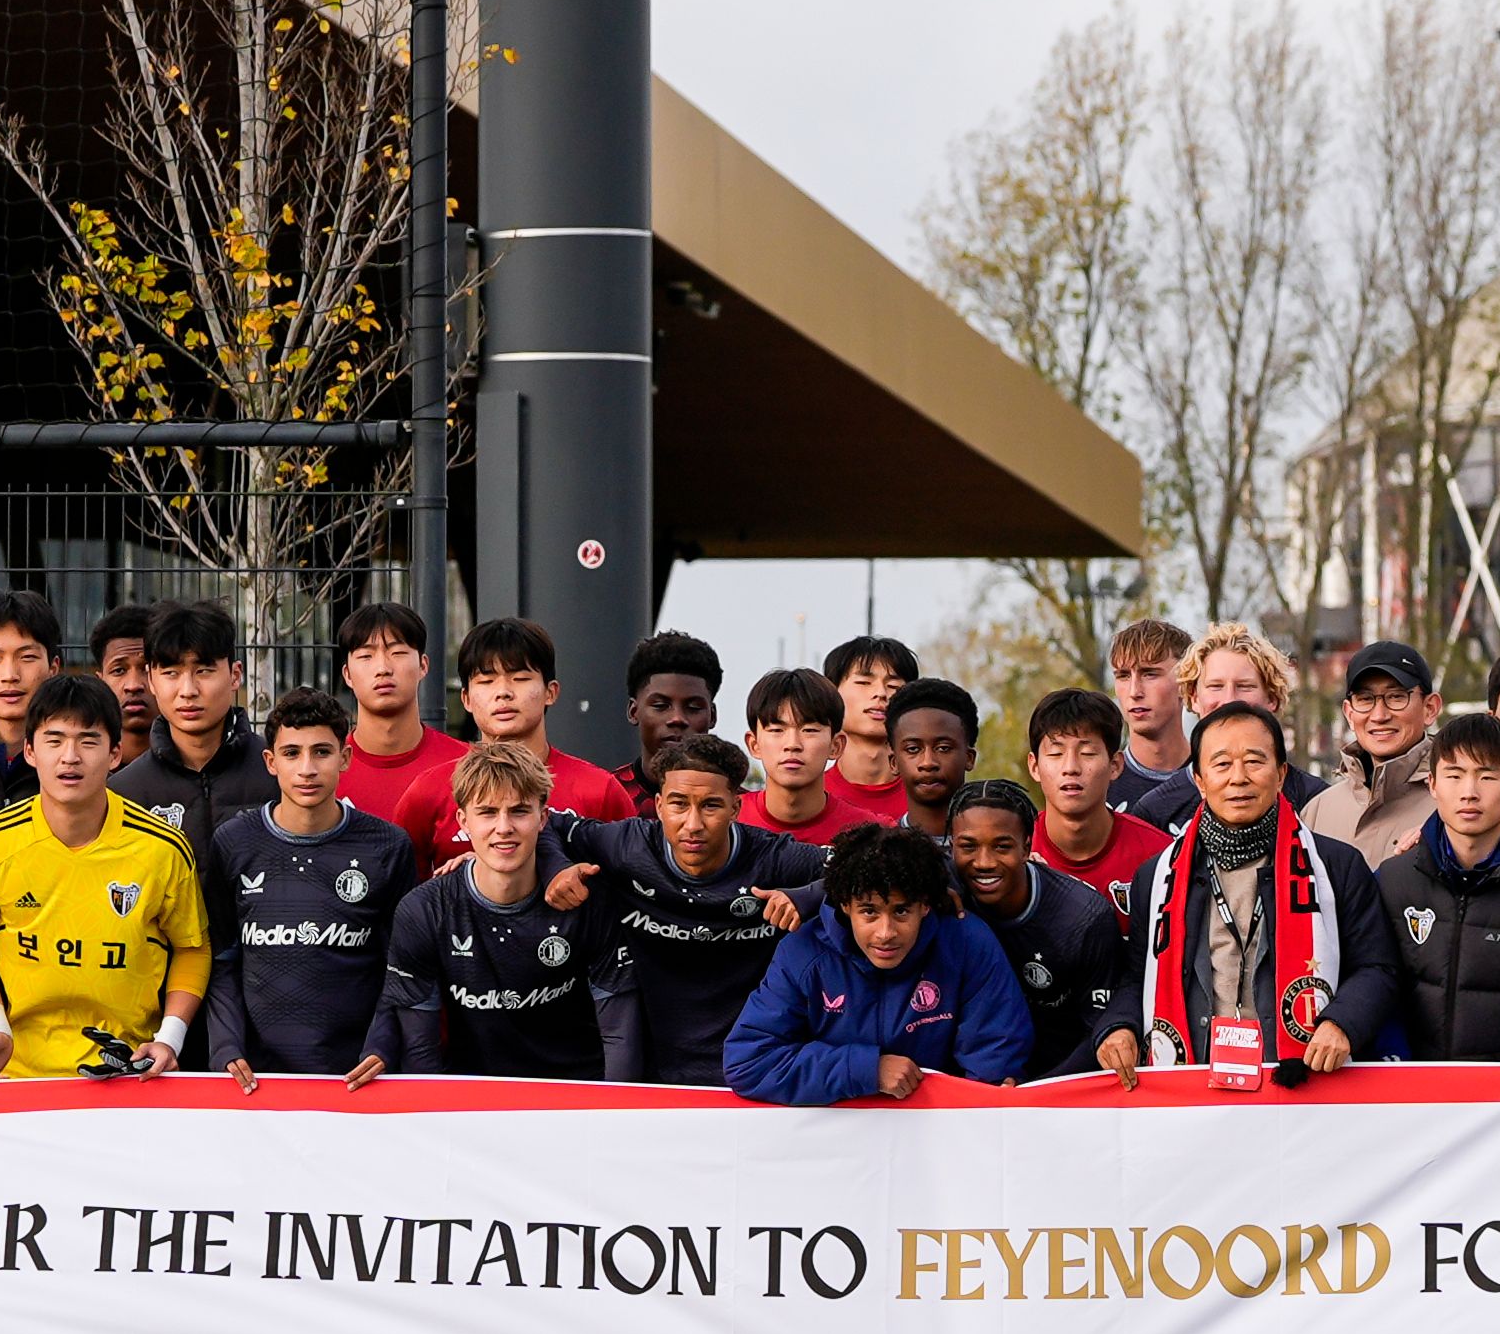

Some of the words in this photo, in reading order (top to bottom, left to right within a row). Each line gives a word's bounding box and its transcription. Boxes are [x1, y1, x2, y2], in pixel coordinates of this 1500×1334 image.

[241, 921, 296, 946] Media
[314, 922, 372, 947] Markt
[621, 910, 690, 941] Media
[17, 931, 127, 969] 보인고
[83, 1205, 234, 1277] THE
[261, 1211, 721, 1296] INVITATION
[747, 1224, 868, 1299] TO
[895, 1221, 1392, 1301] FEYENOORD
